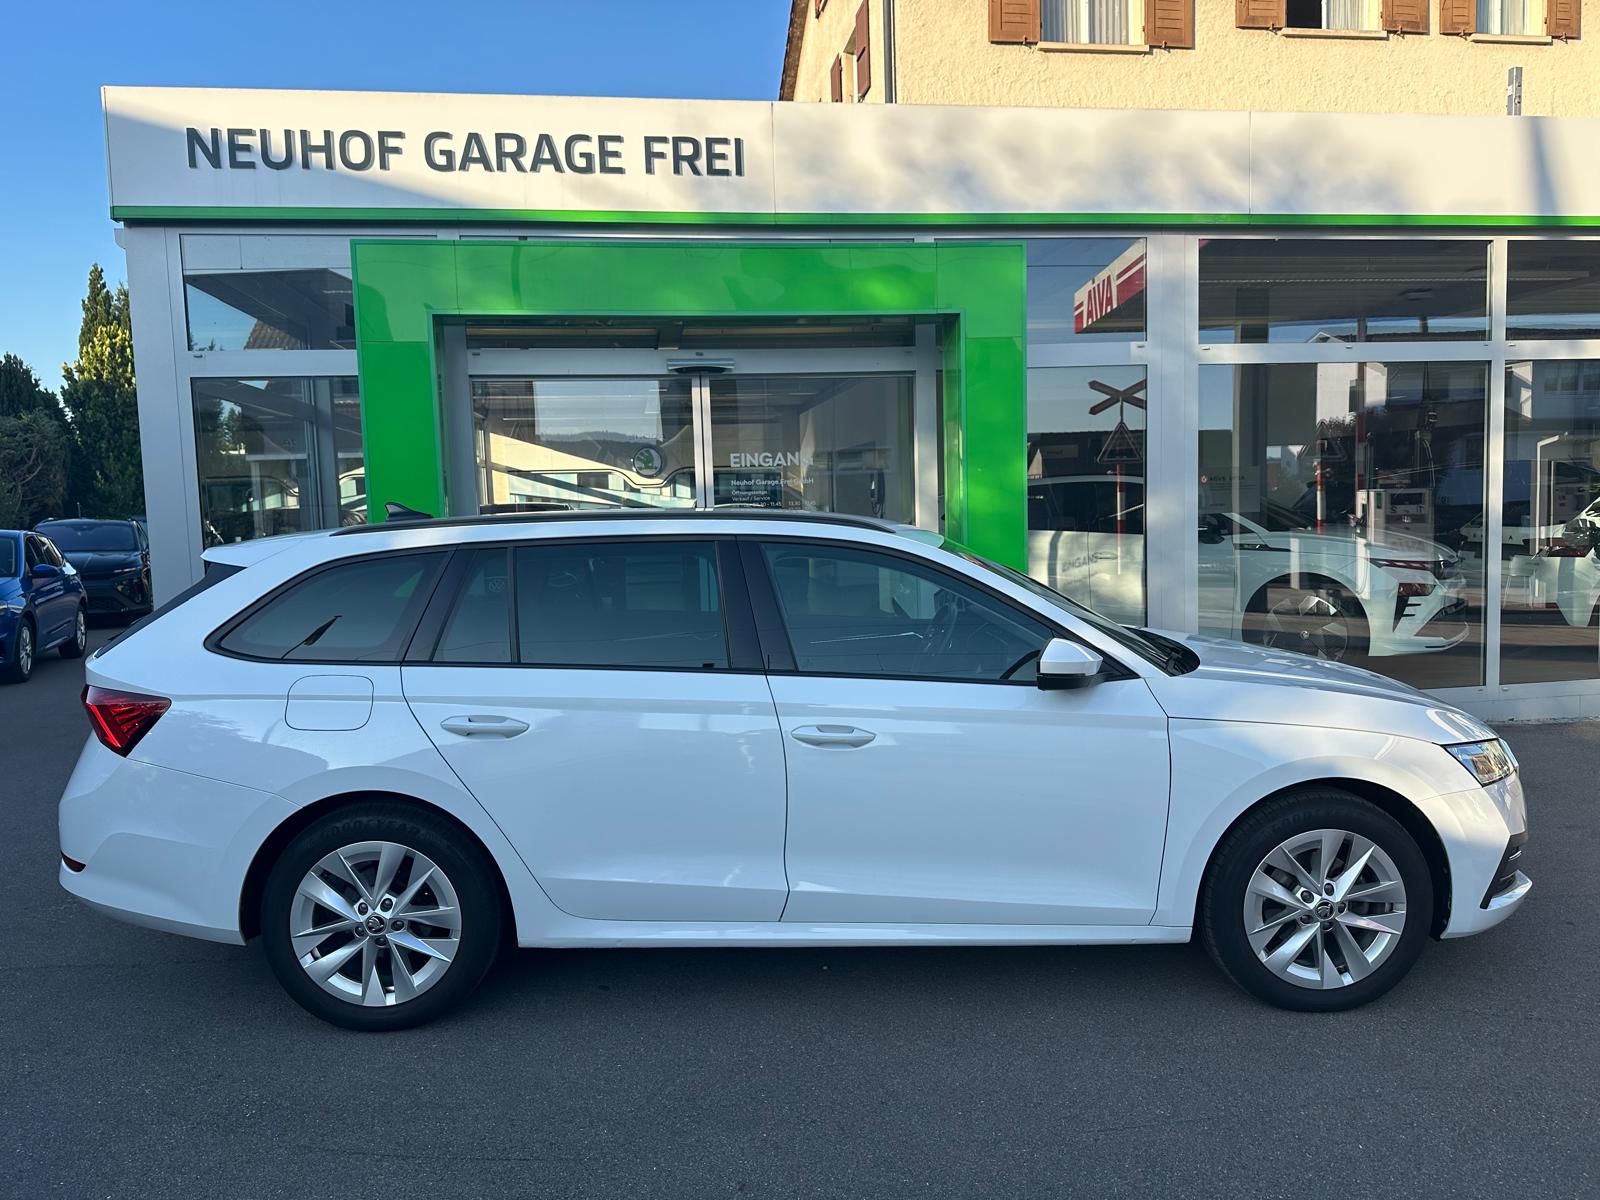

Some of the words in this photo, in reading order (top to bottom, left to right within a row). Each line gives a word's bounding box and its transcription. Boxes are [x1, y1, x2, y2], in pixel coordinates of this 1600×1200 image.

[187, 127, 406, 170] NEUHOF
[424, 131, 625, 174] GARAGE
[644, 135, 745, 176] FREI
[730, 479, 755, 487] Neuhof
[755, 478, 779, 487] Garage
